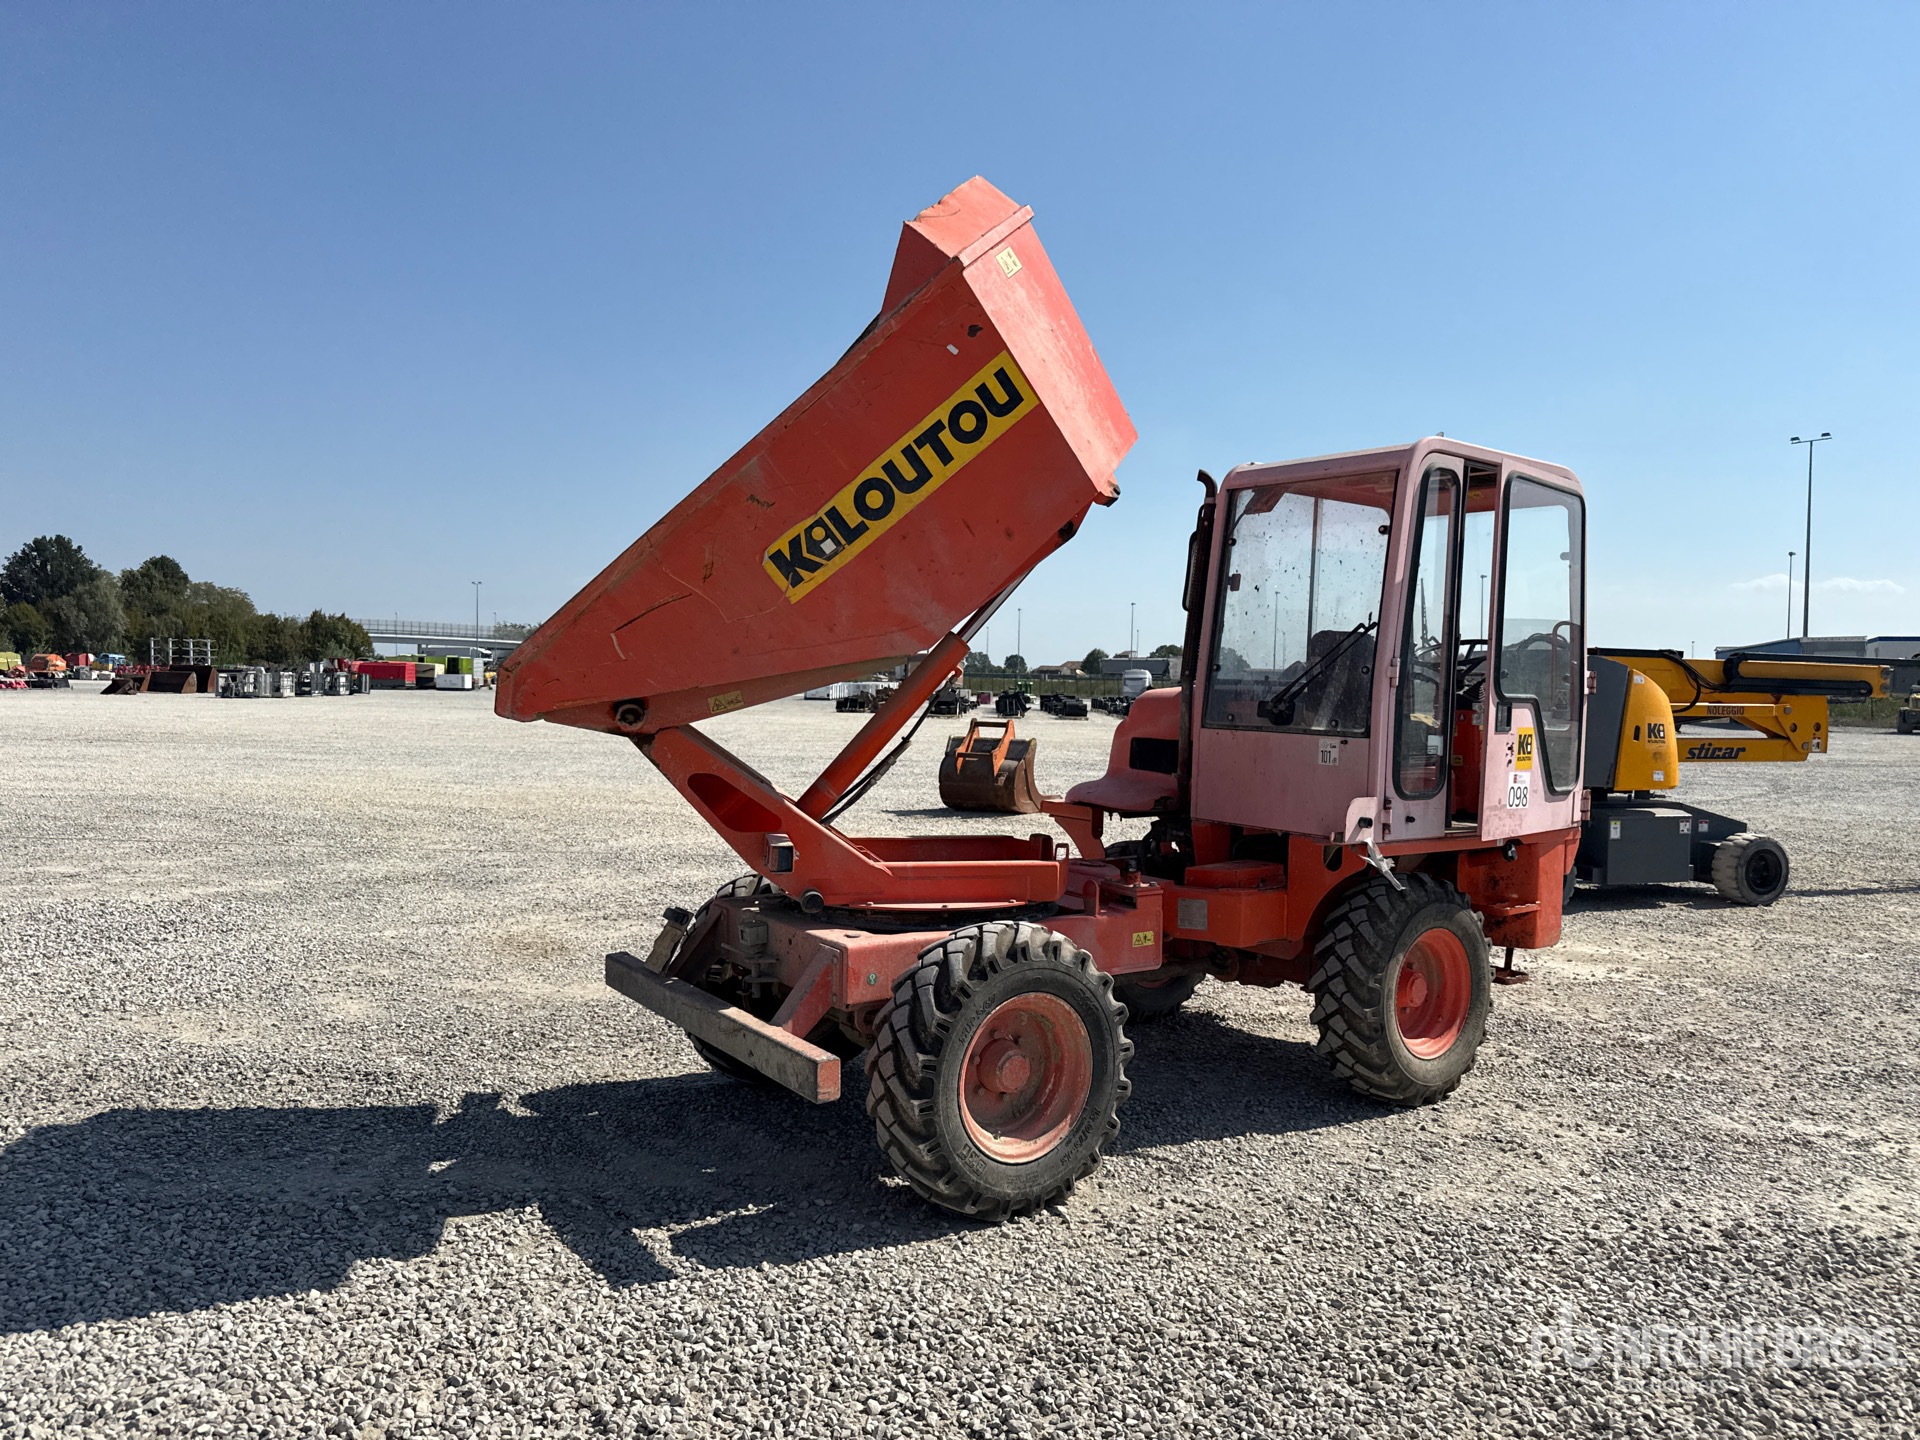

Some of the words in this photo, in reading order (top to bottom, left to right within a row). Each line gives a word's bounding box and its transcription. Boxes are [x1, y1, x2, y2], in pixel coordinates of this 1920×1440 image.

[1706, 705, 1745, 716] NOLEGGIO
[1320, 749, 1331, 764] 101
[1507, 786, 1529, 808] 098
